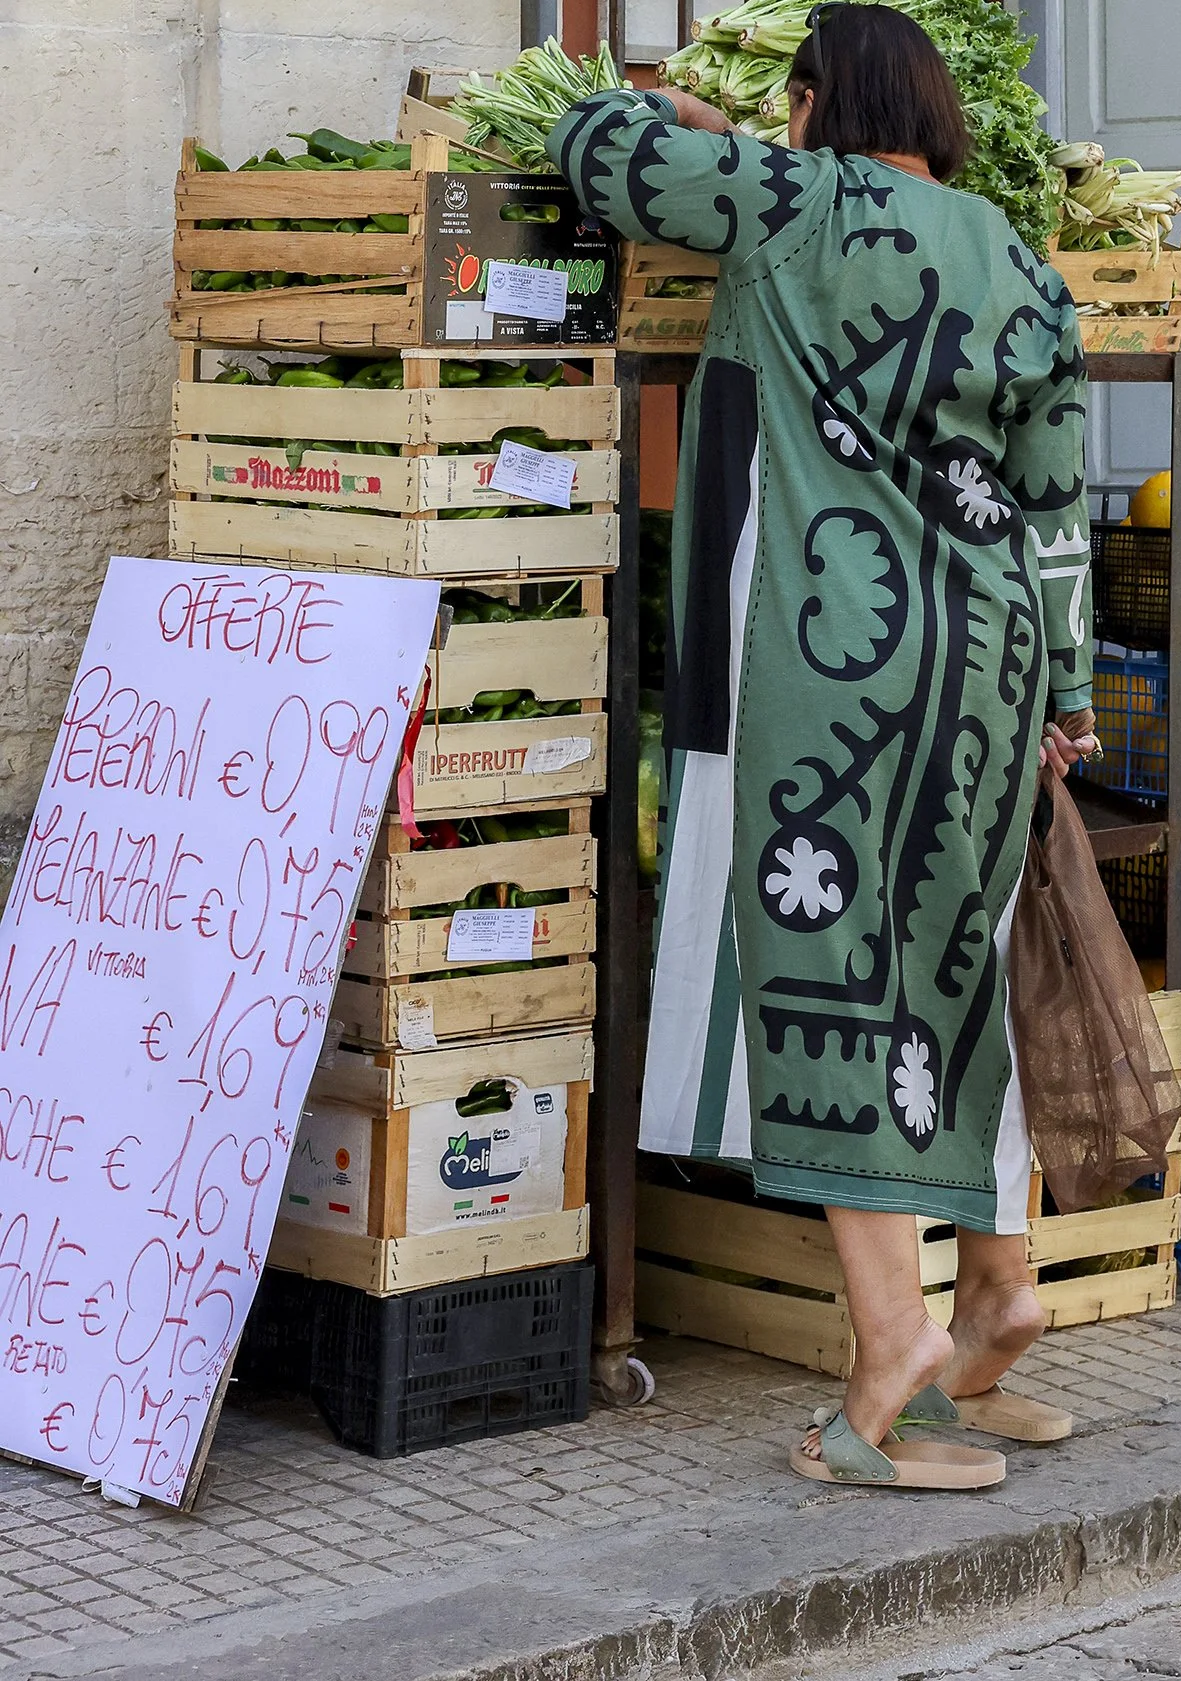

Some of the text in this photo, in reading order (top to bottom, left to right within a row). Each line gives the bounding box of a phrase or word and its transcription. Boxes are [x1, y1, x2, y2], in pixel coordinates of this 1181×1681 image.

[490, 182, 520, 190] VITTORIA
[507, 327, 525, 335] VISTA
[248, 455, 342, 494] Mazzoni
[158, 573, 344, 664] OFFERTE
[217, 750, 254, 798] €
[431, 748, 529, 776] IPERFRUTT
[192, 888, 224, 938] €
[139, 1010, 174, 1062] €
[101, 1135, 142, 1191] €
[0, 1212, 86, 1327] ANE
[78, 1279, 115, 1336] €
[40, 1402, 75, 1452] €
